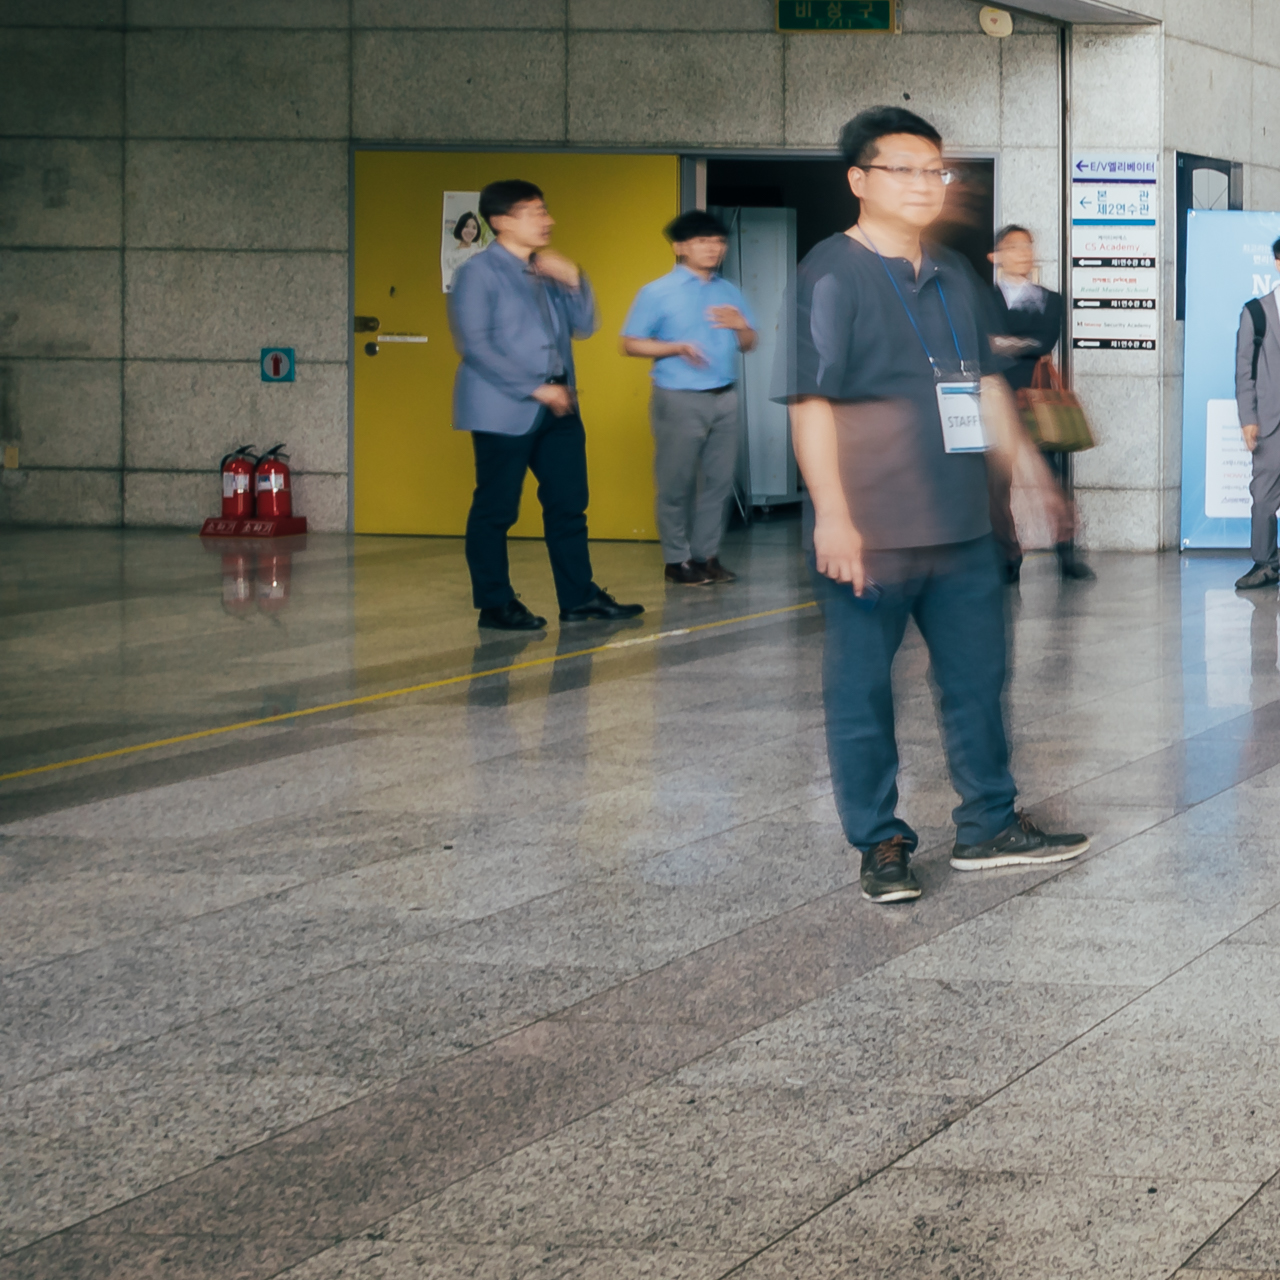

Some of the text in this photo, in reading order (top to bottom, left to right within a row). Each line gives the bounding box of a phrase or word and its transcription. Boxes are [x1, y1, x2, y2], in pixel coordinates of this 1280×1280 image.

[795, 0, 874, 20] 비상구
[1096, 203, 1150, 216] 제2연수관
[1084, 242, 1141, 252] CS Academy
[947, 415, 979, 429] STAFF
